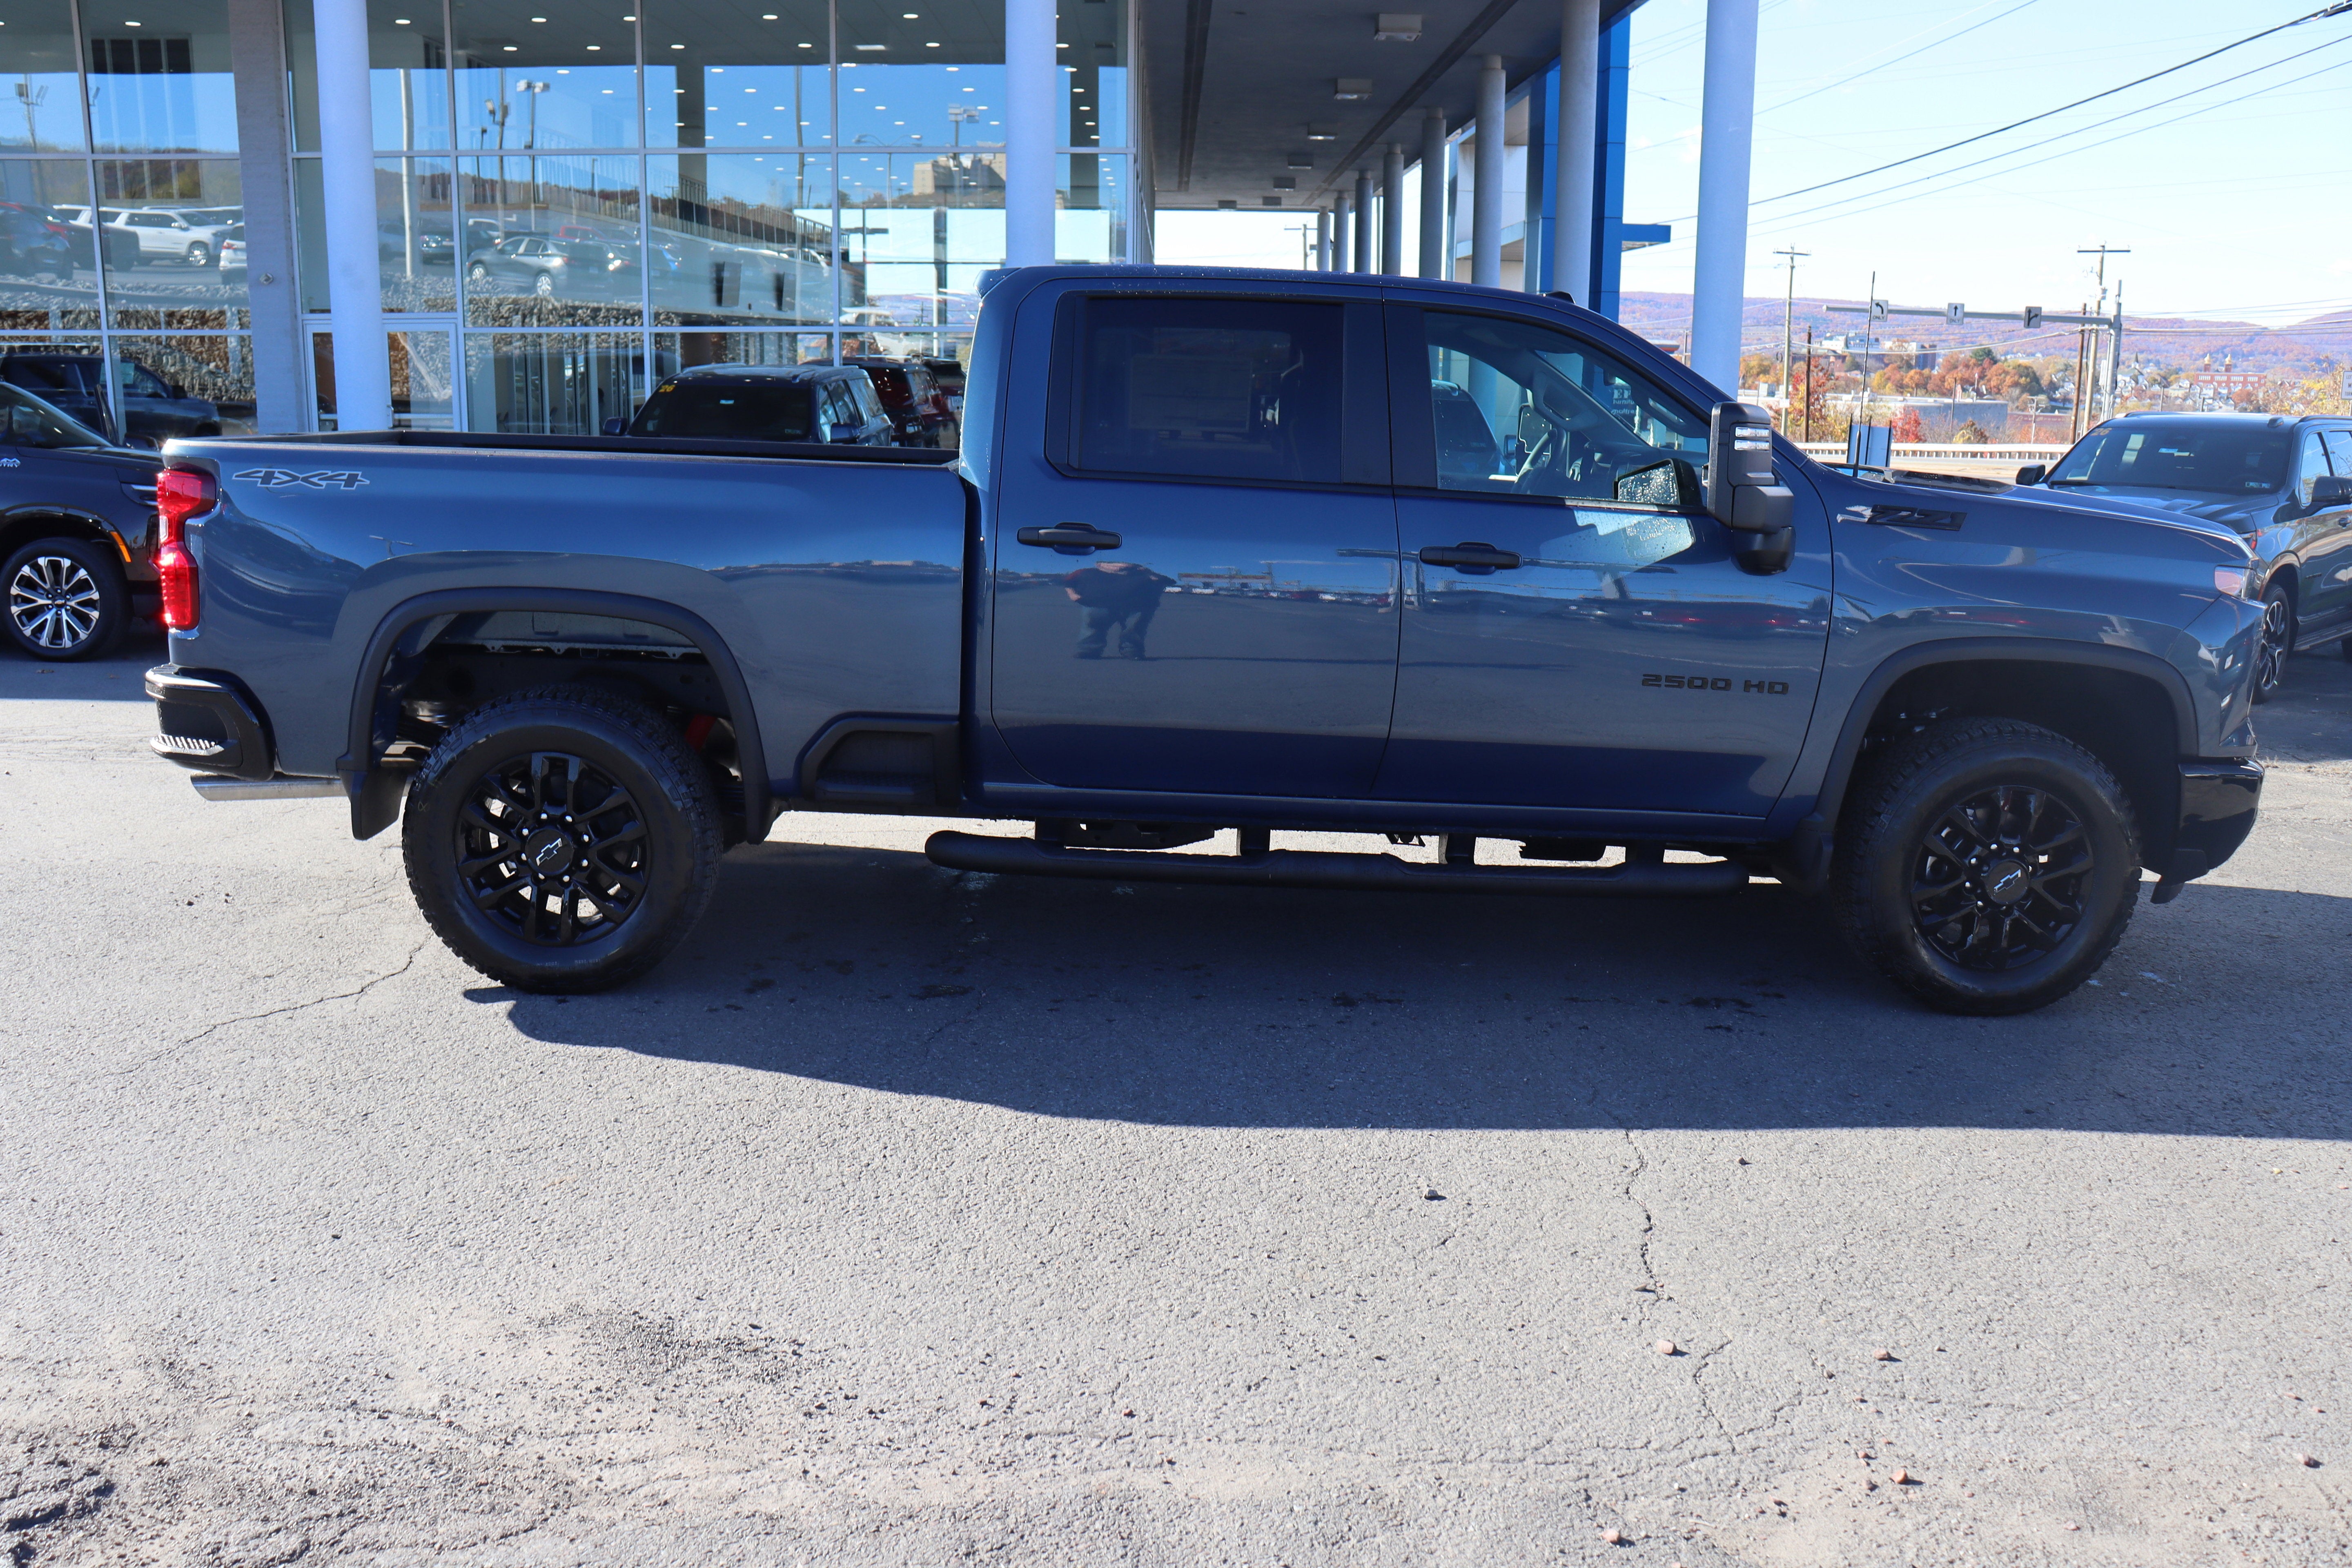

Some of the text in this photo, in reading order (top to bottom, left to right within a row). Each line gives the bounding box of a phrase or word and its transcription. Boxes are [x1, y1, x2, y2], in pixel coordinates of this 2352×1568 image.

[2090, 428, 2112, 436] 26
[1642, 673, 1789, 695] 2500 HD
